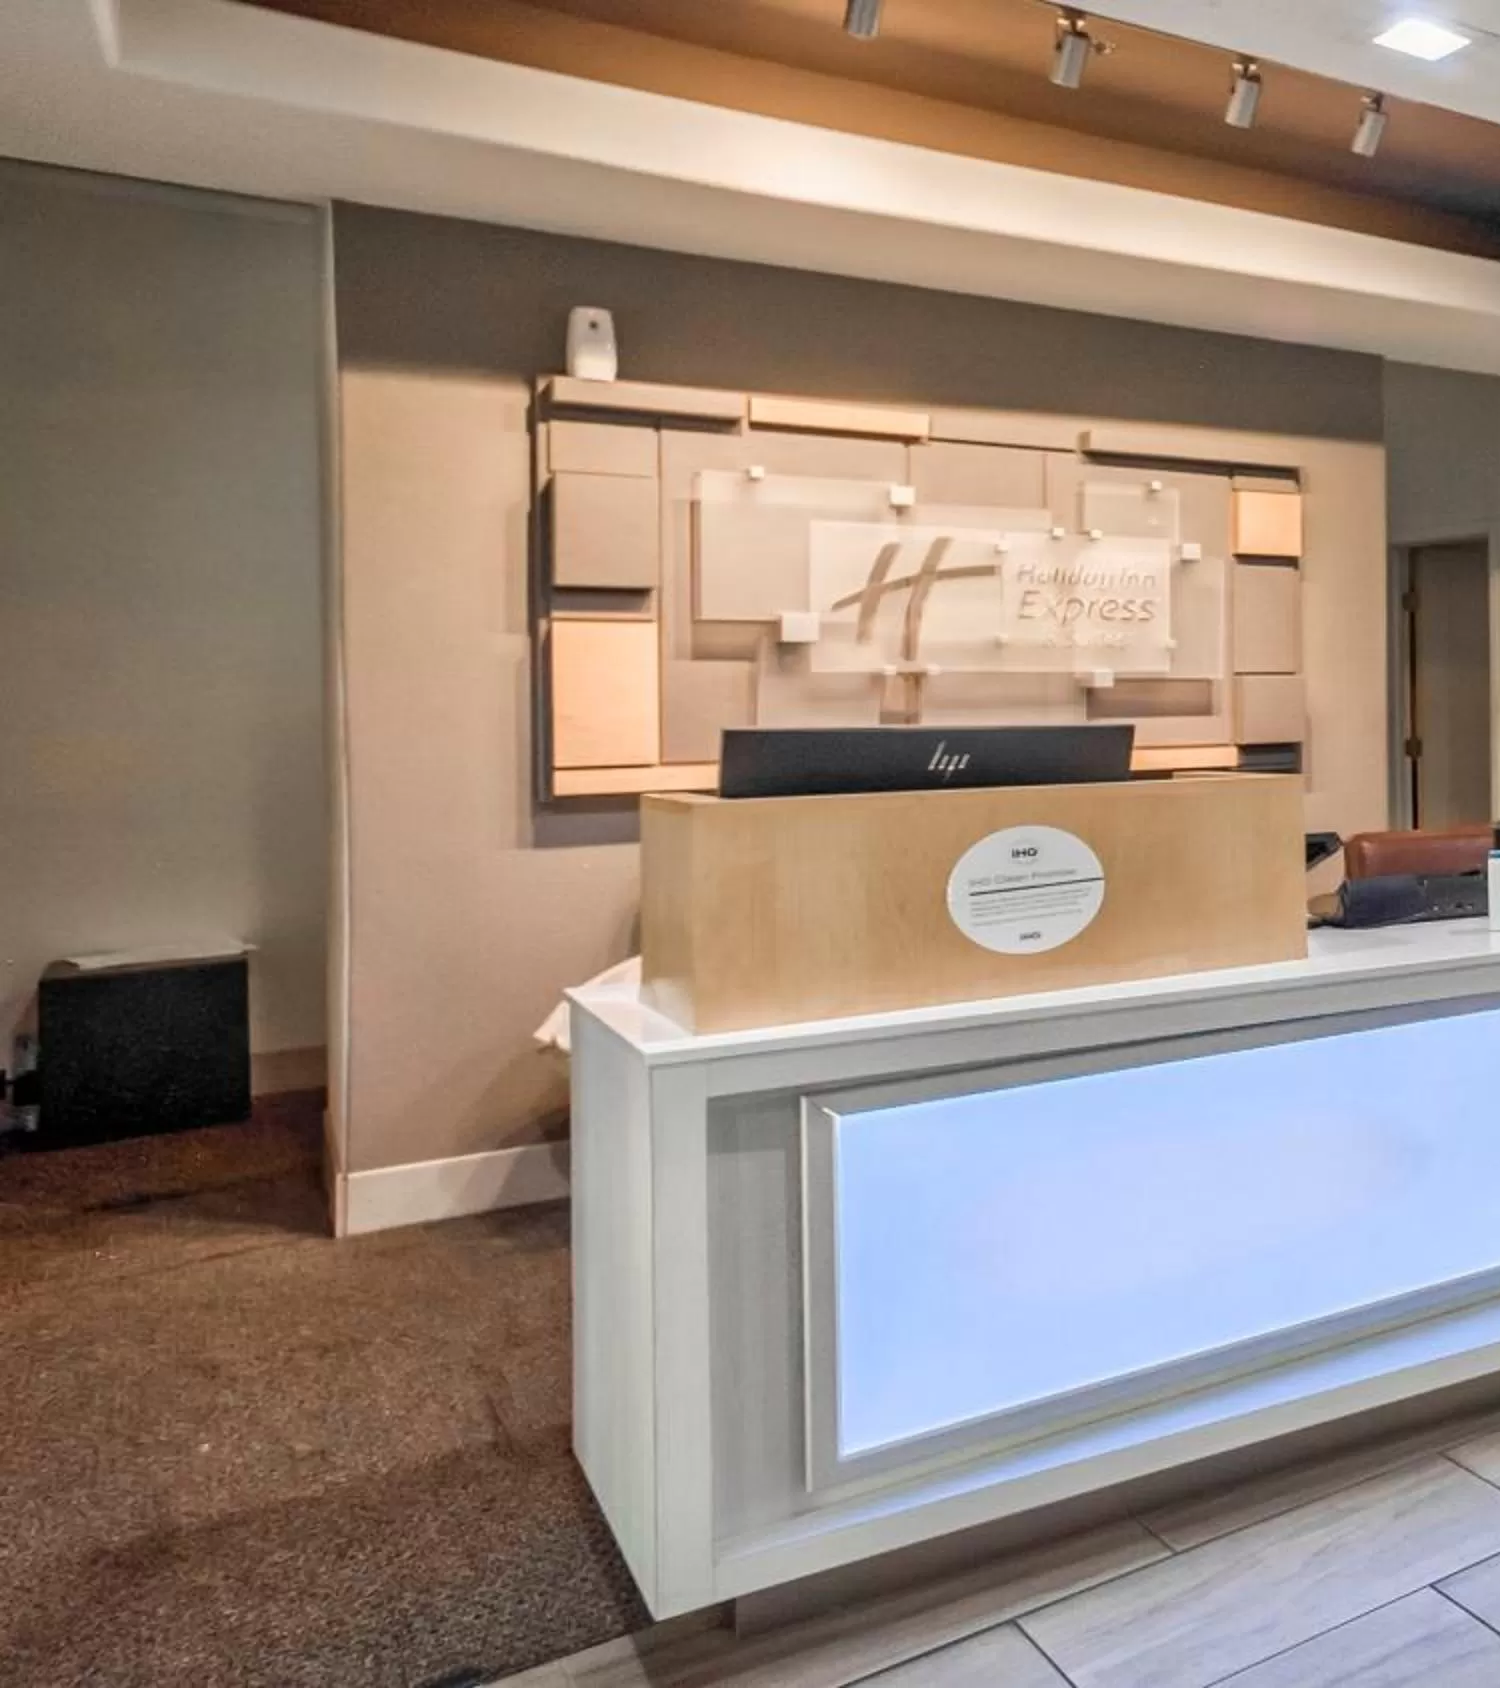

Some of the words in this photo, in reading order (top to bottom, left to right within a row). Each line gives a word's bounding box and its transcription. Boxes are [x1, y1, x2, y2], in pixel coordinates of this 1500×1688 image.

[1016, 564, 1114, 590] Holiday
[1119, 567, 1156, 588] Inn
[1017, 590, 1156, 625] Express
[928, 740, 971, 782] hp
